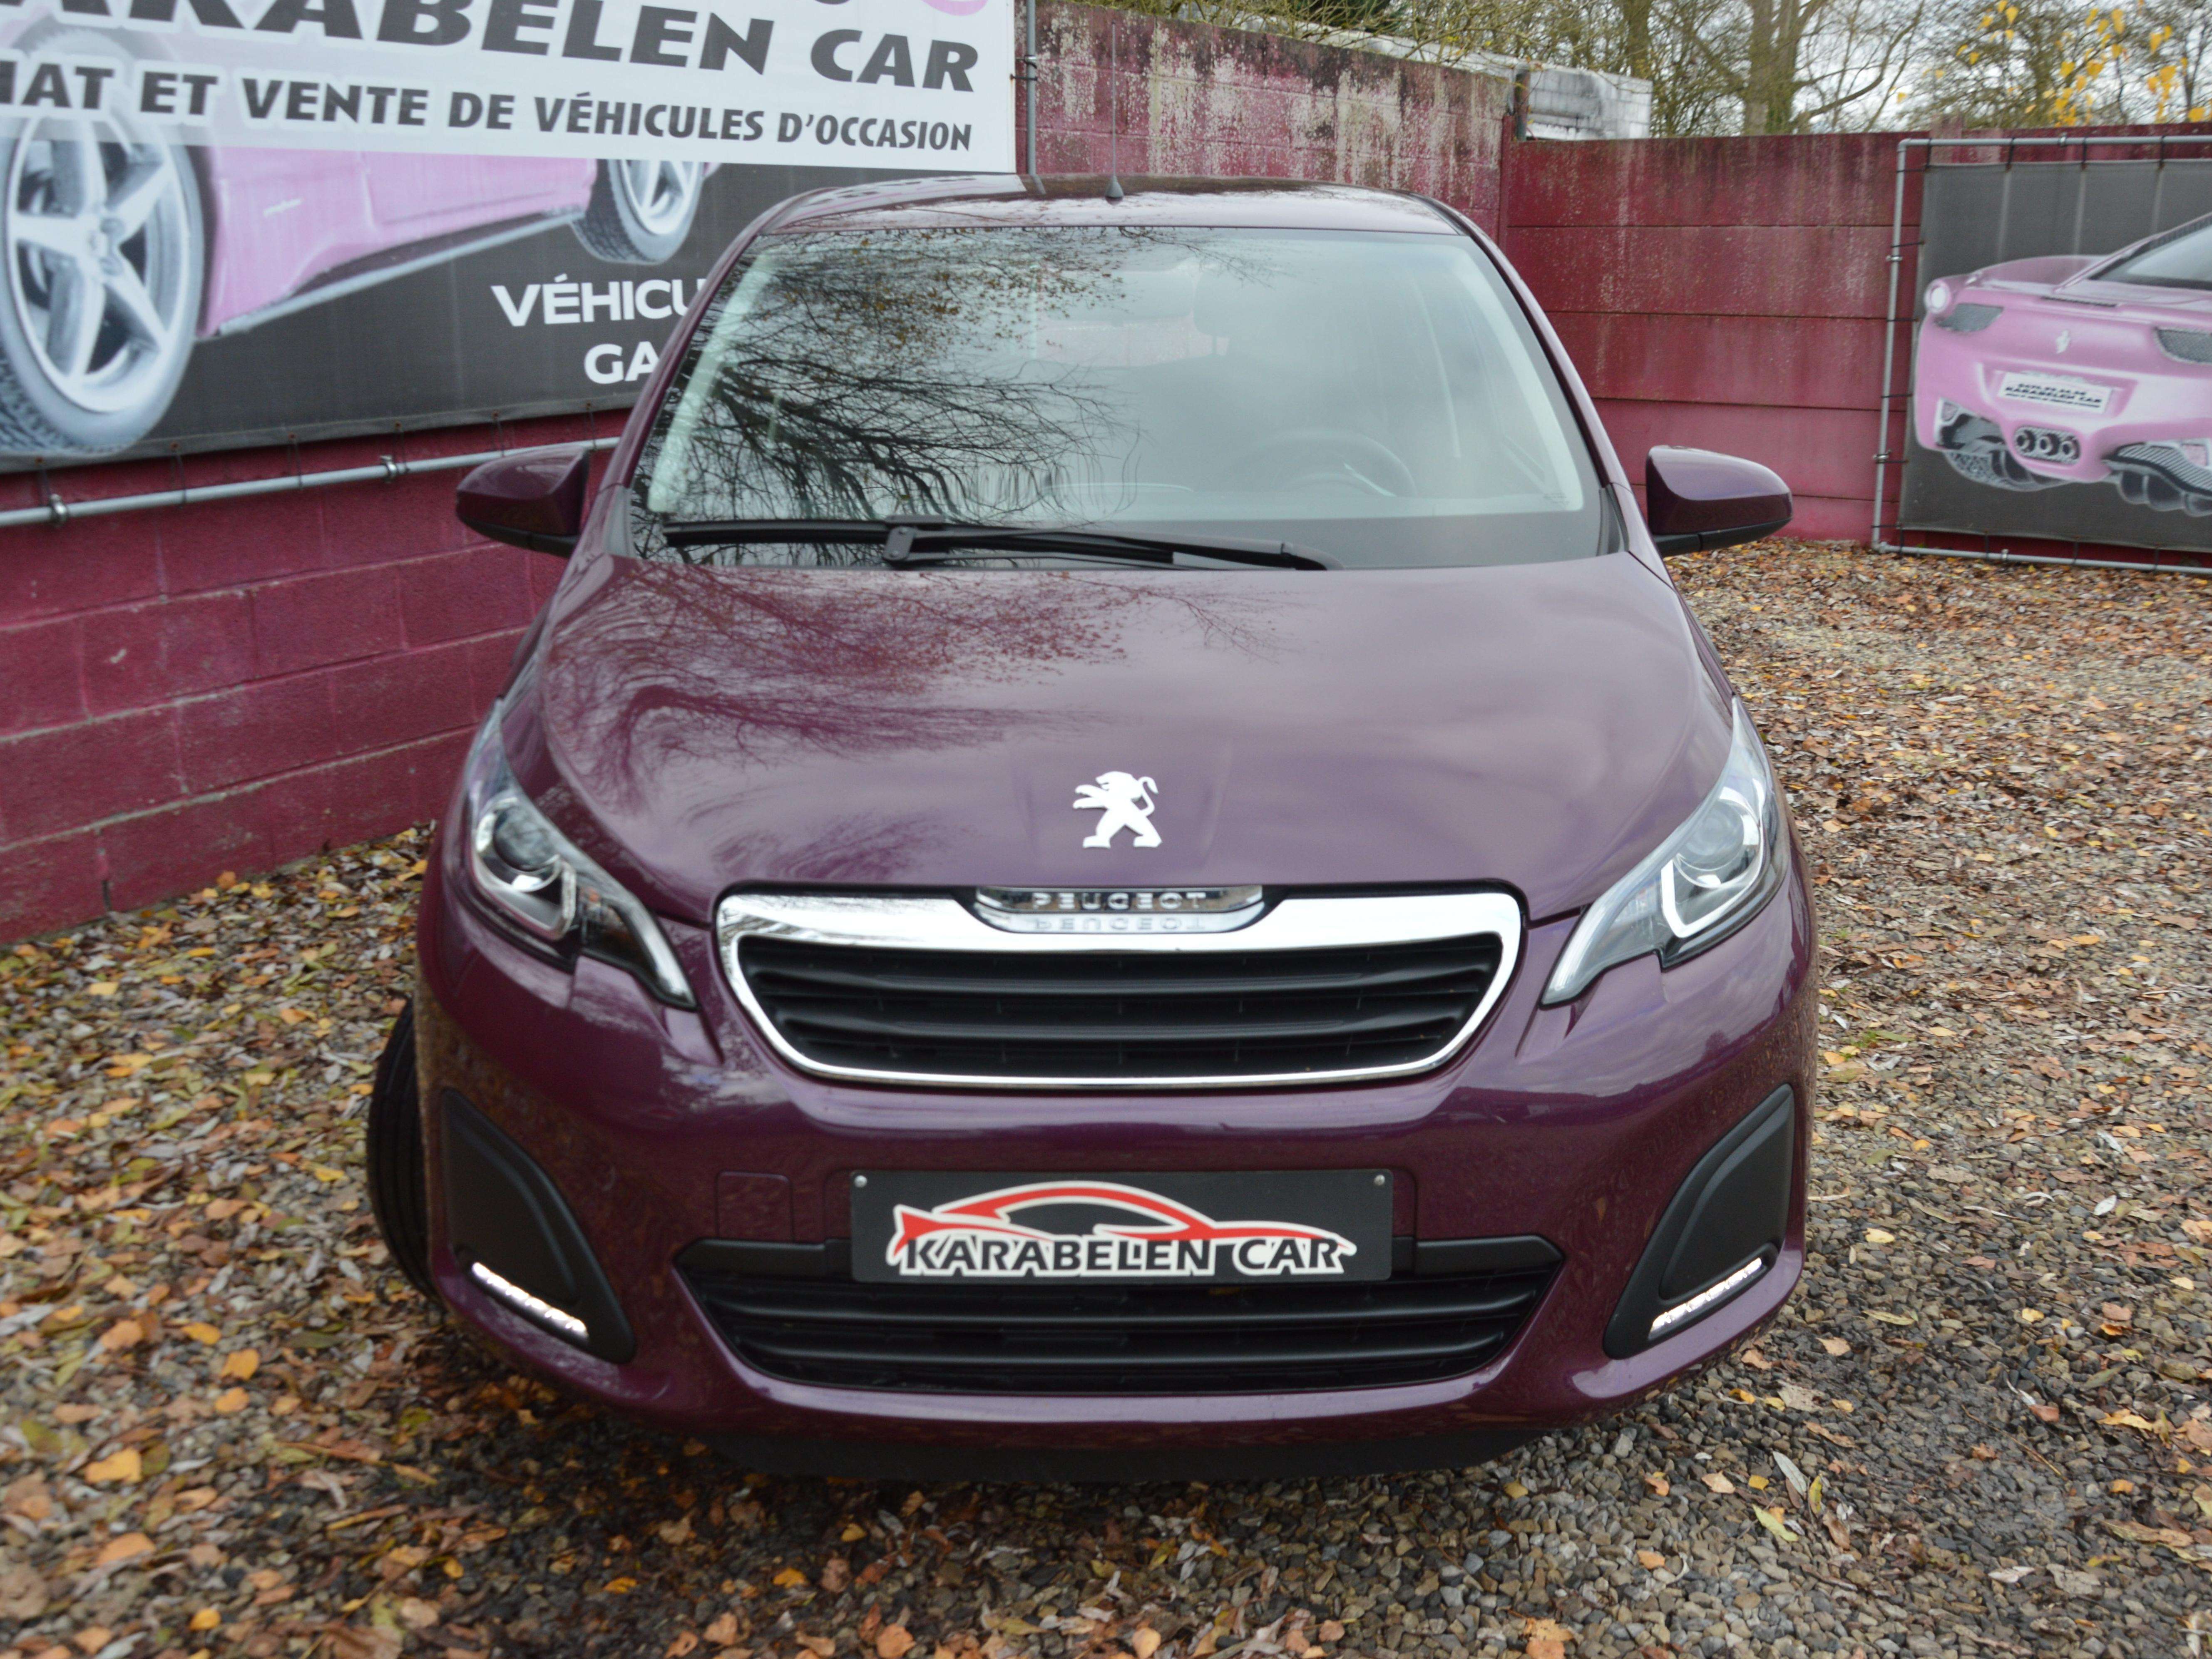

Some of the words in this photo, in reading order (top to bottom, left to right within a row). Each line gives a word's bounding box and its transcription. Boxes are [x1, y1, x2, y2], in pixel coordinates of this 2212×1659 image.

[0, 0, 774, 75] ABELEN
[810, 29, 978, 92] CAR
[140, 71, 219, 115] ET
[242, 78, 429, 126] VENTE
[448, 92, 515, 130] DE
[534, 92, 764, 141] VÉHICULES
[777, 112, 972, 151] D'OCCASION
[1031, 892, 1206, 910] PEUGEOT
[906, 1238, 1210, 1271] KARABELEN
[1238, 1238, 1339, 1269] CAR
